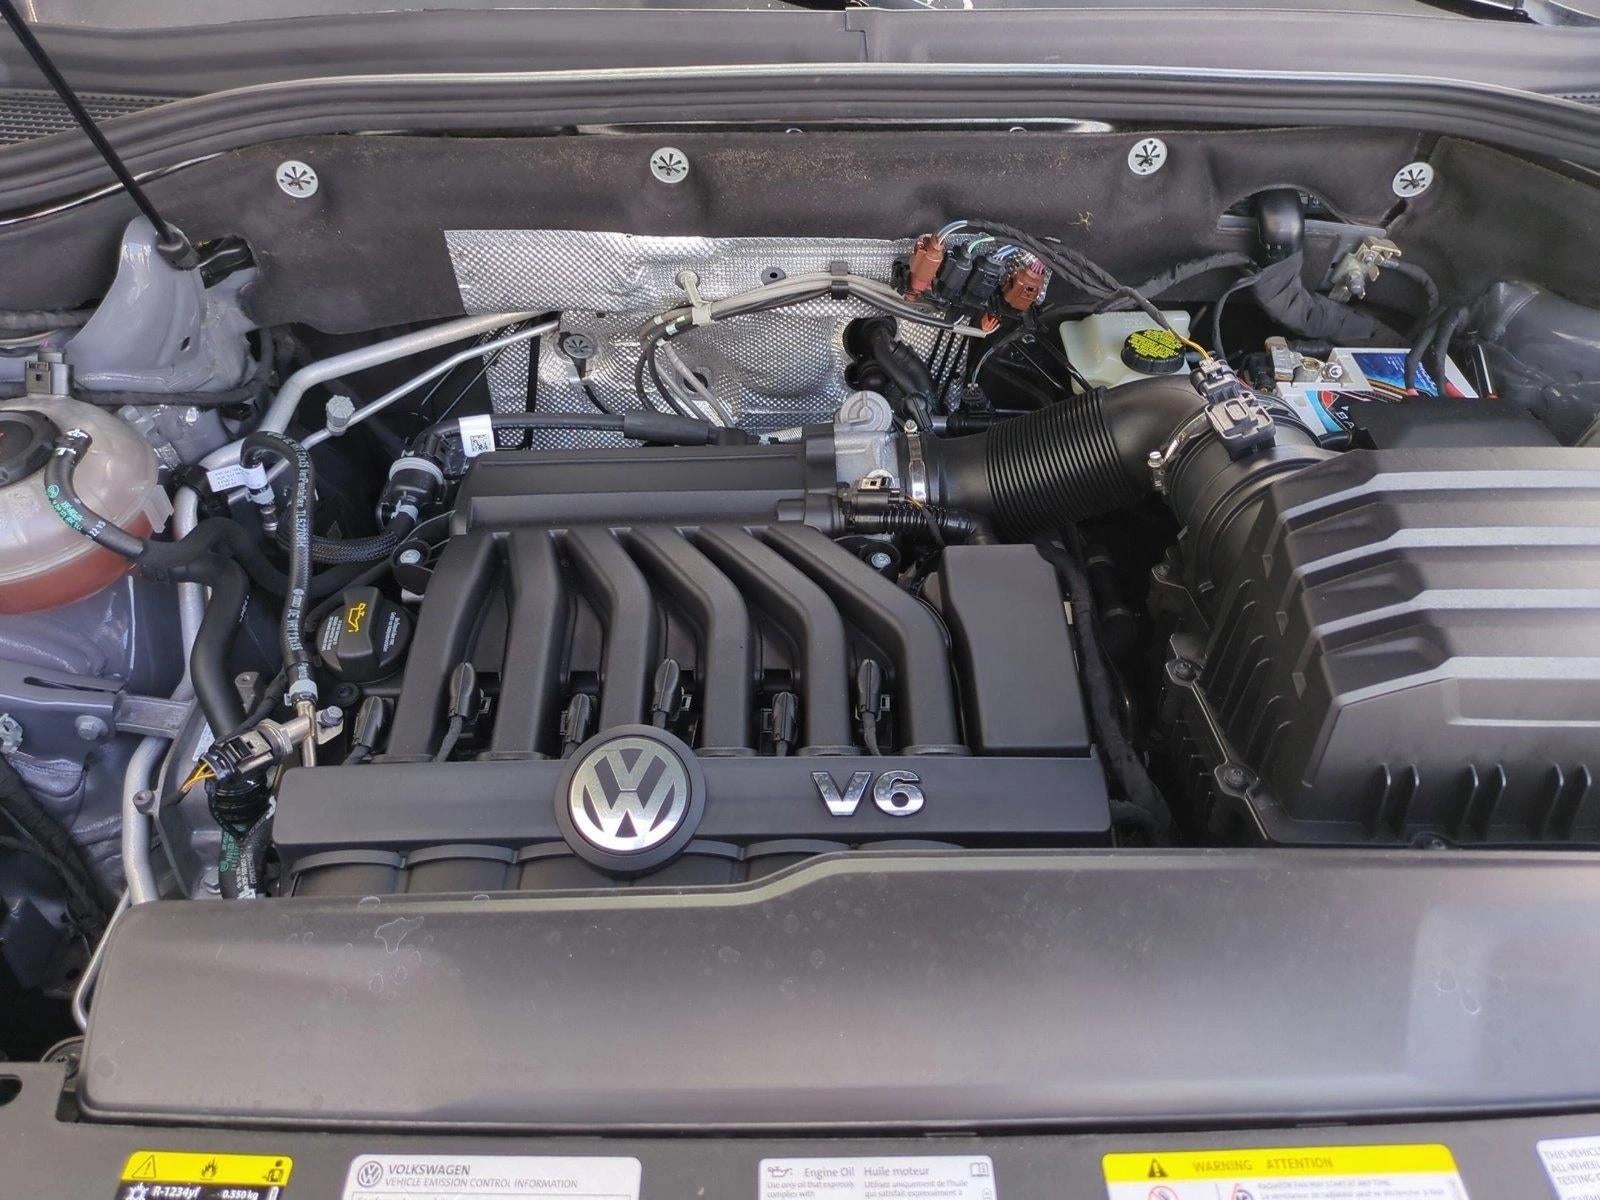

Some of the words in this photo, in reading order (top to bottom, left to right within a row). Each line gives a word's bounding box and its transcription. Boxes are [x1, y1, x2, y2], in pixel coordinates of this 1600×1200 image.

[811, 769, 925, 817] V6
[388, 1164, 470, 1176] VOLKSWAGEN
[1192, 1159, 1252, 1172] WARNING
[1266, 1157, 1333, 1170] ATTENTION
[804, 1168, 838, 1179] Engine
[840, 1167, 855, 1177] Oil
[864, 1166, 889, 1176] Huile
[892, 1167, 929, 1176] moteur
[385, 1177, 421, 1188] VEHICLE
[423, 1177, 468, 1188] EMISSION
[470, 1178, 512, 1188] CONTROL
[514, 1179, 578, 1189] INFORMATION
[152, 1185, 201, 1199] R-1234yf
